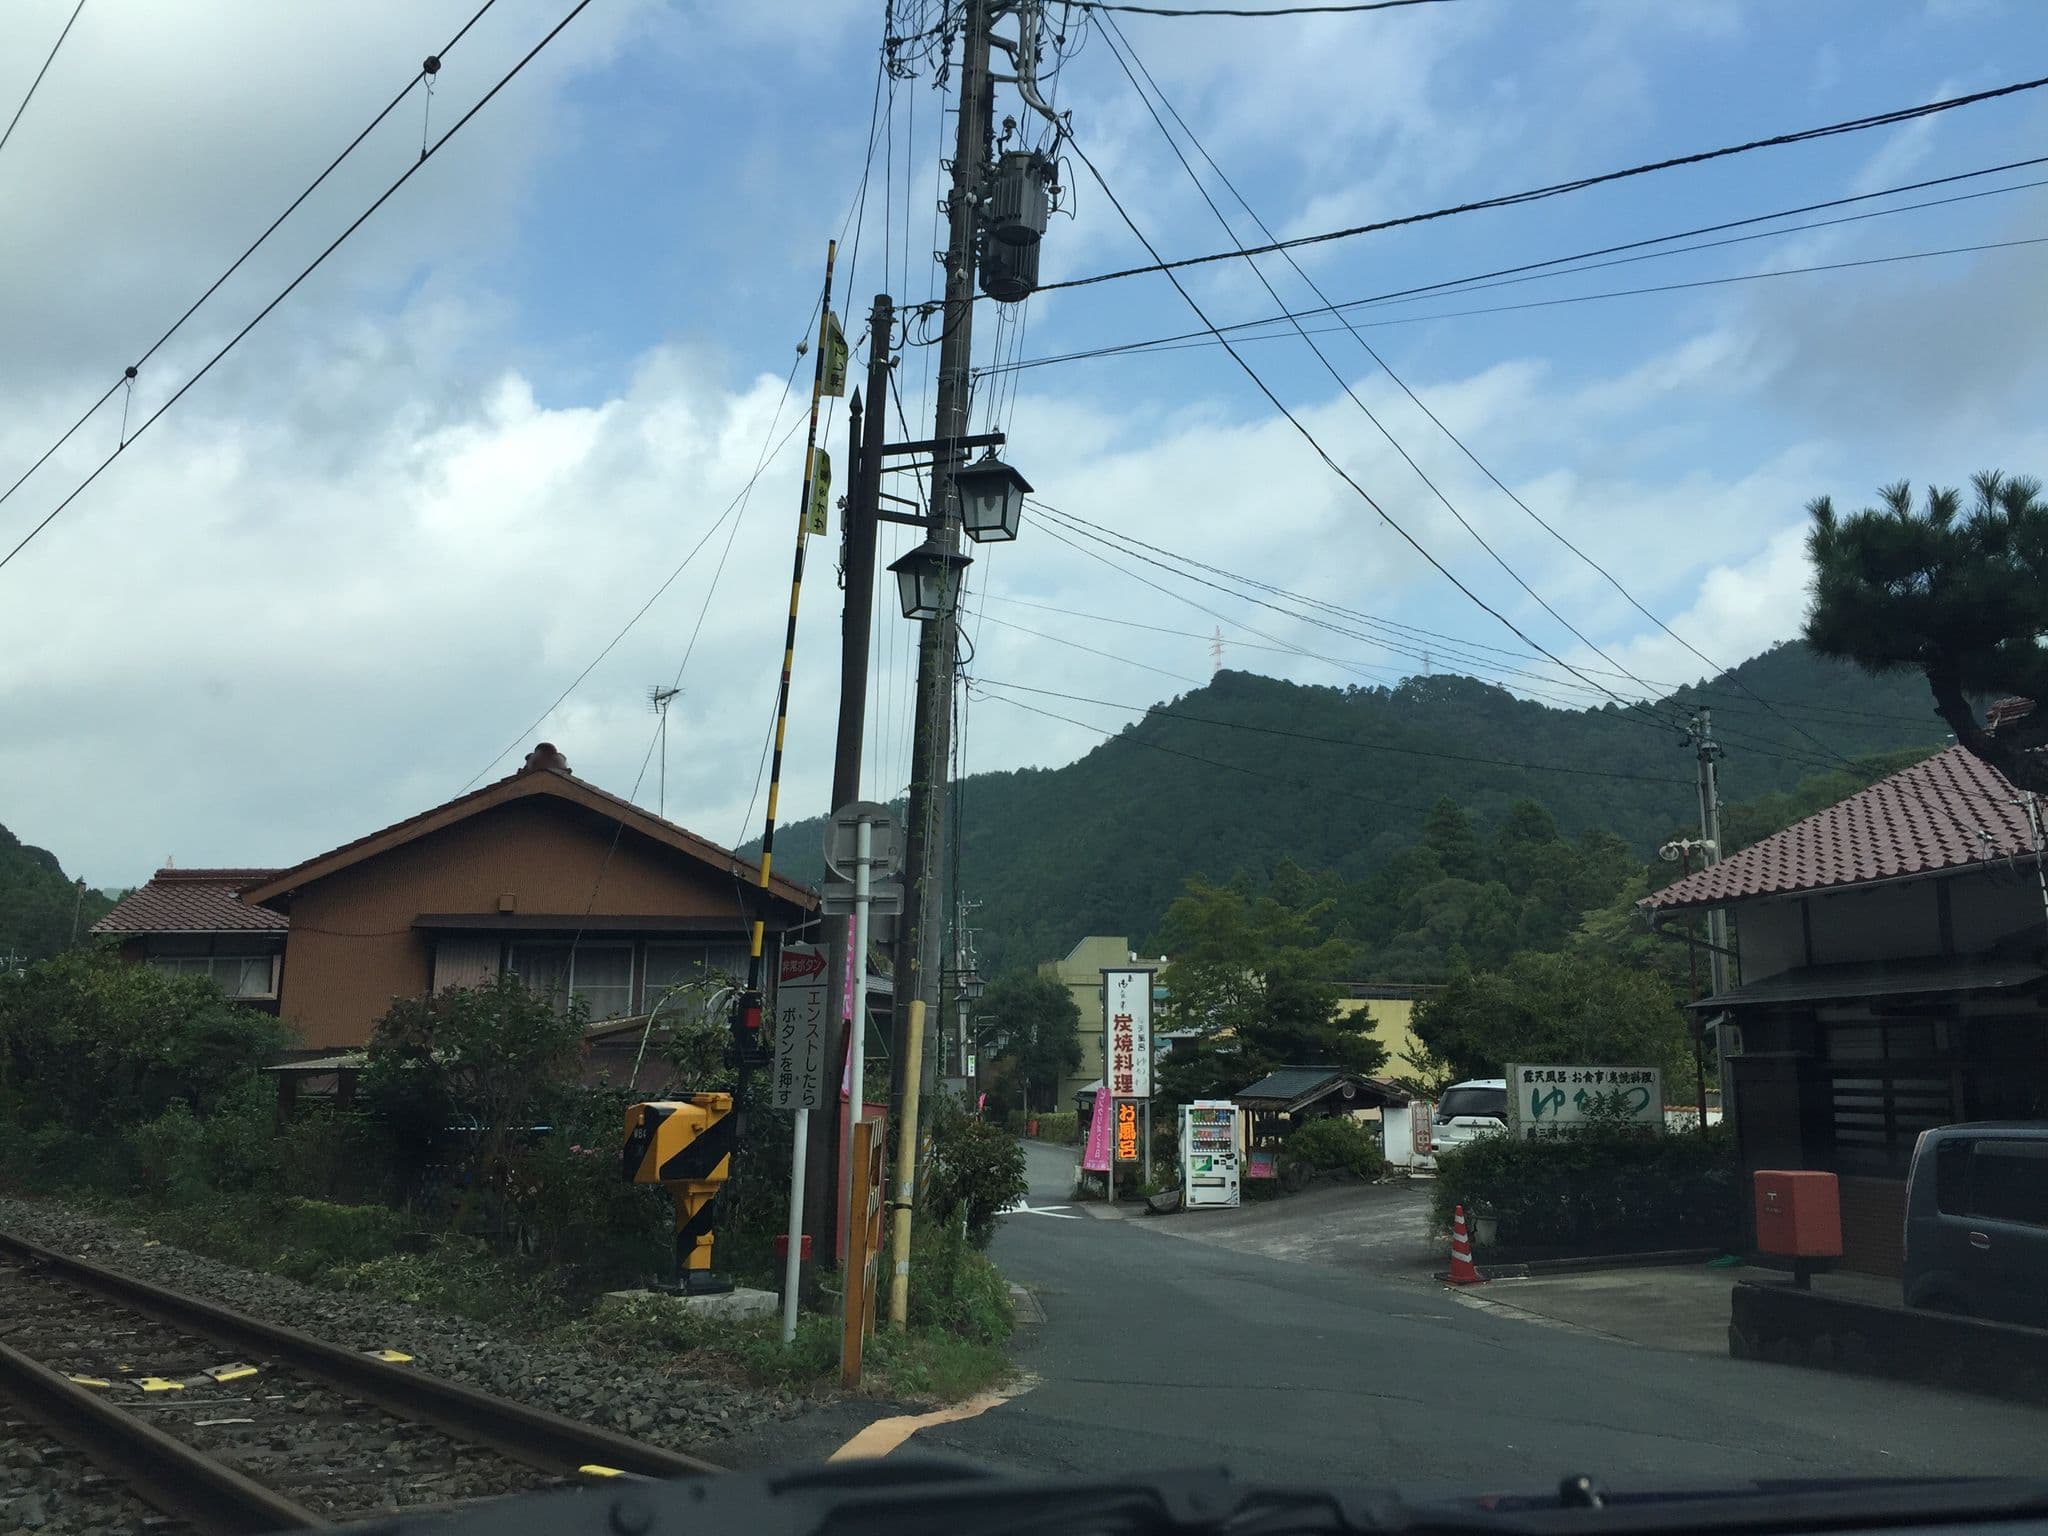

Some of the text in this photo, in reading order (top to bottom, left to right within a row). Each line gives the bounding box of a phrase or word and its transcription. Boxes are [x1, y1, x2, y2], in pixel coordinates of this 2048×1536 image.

[782, 958, 822, 974] 非常ボタン
[778, 1008, 796, 1105] ボタンを押す
[802, 991, 821, 1107] エンストしたら
[1113, 1013, 1134, 1094] 炭焼料理
[1118, 1103, 1137, 1160] お風呂
